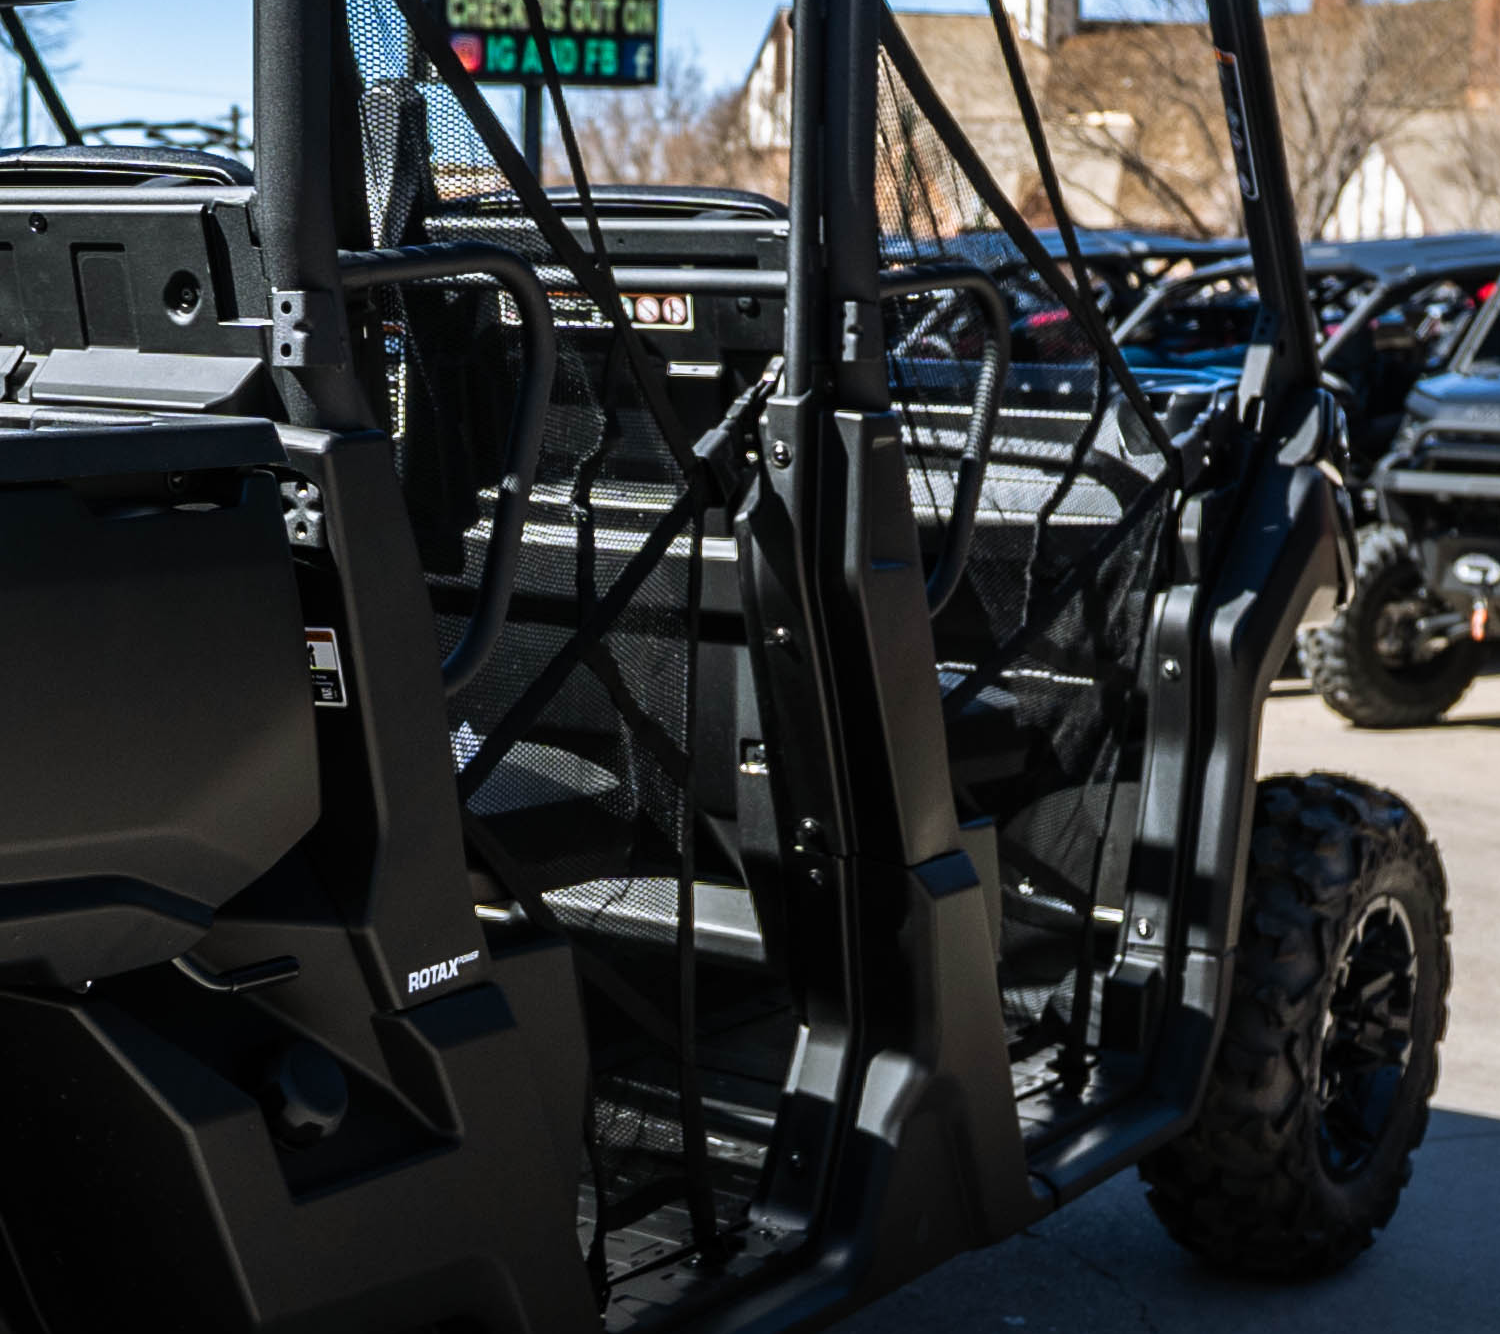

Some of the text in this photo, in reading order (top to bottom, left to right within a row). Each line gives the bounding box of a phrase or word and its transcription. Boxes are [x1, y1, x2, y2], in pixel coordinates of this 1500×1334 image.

[486, 33, 517, 73] IG
[583, 37, 619, 77] FB
[408, 957, 459, 994] ROTAX
